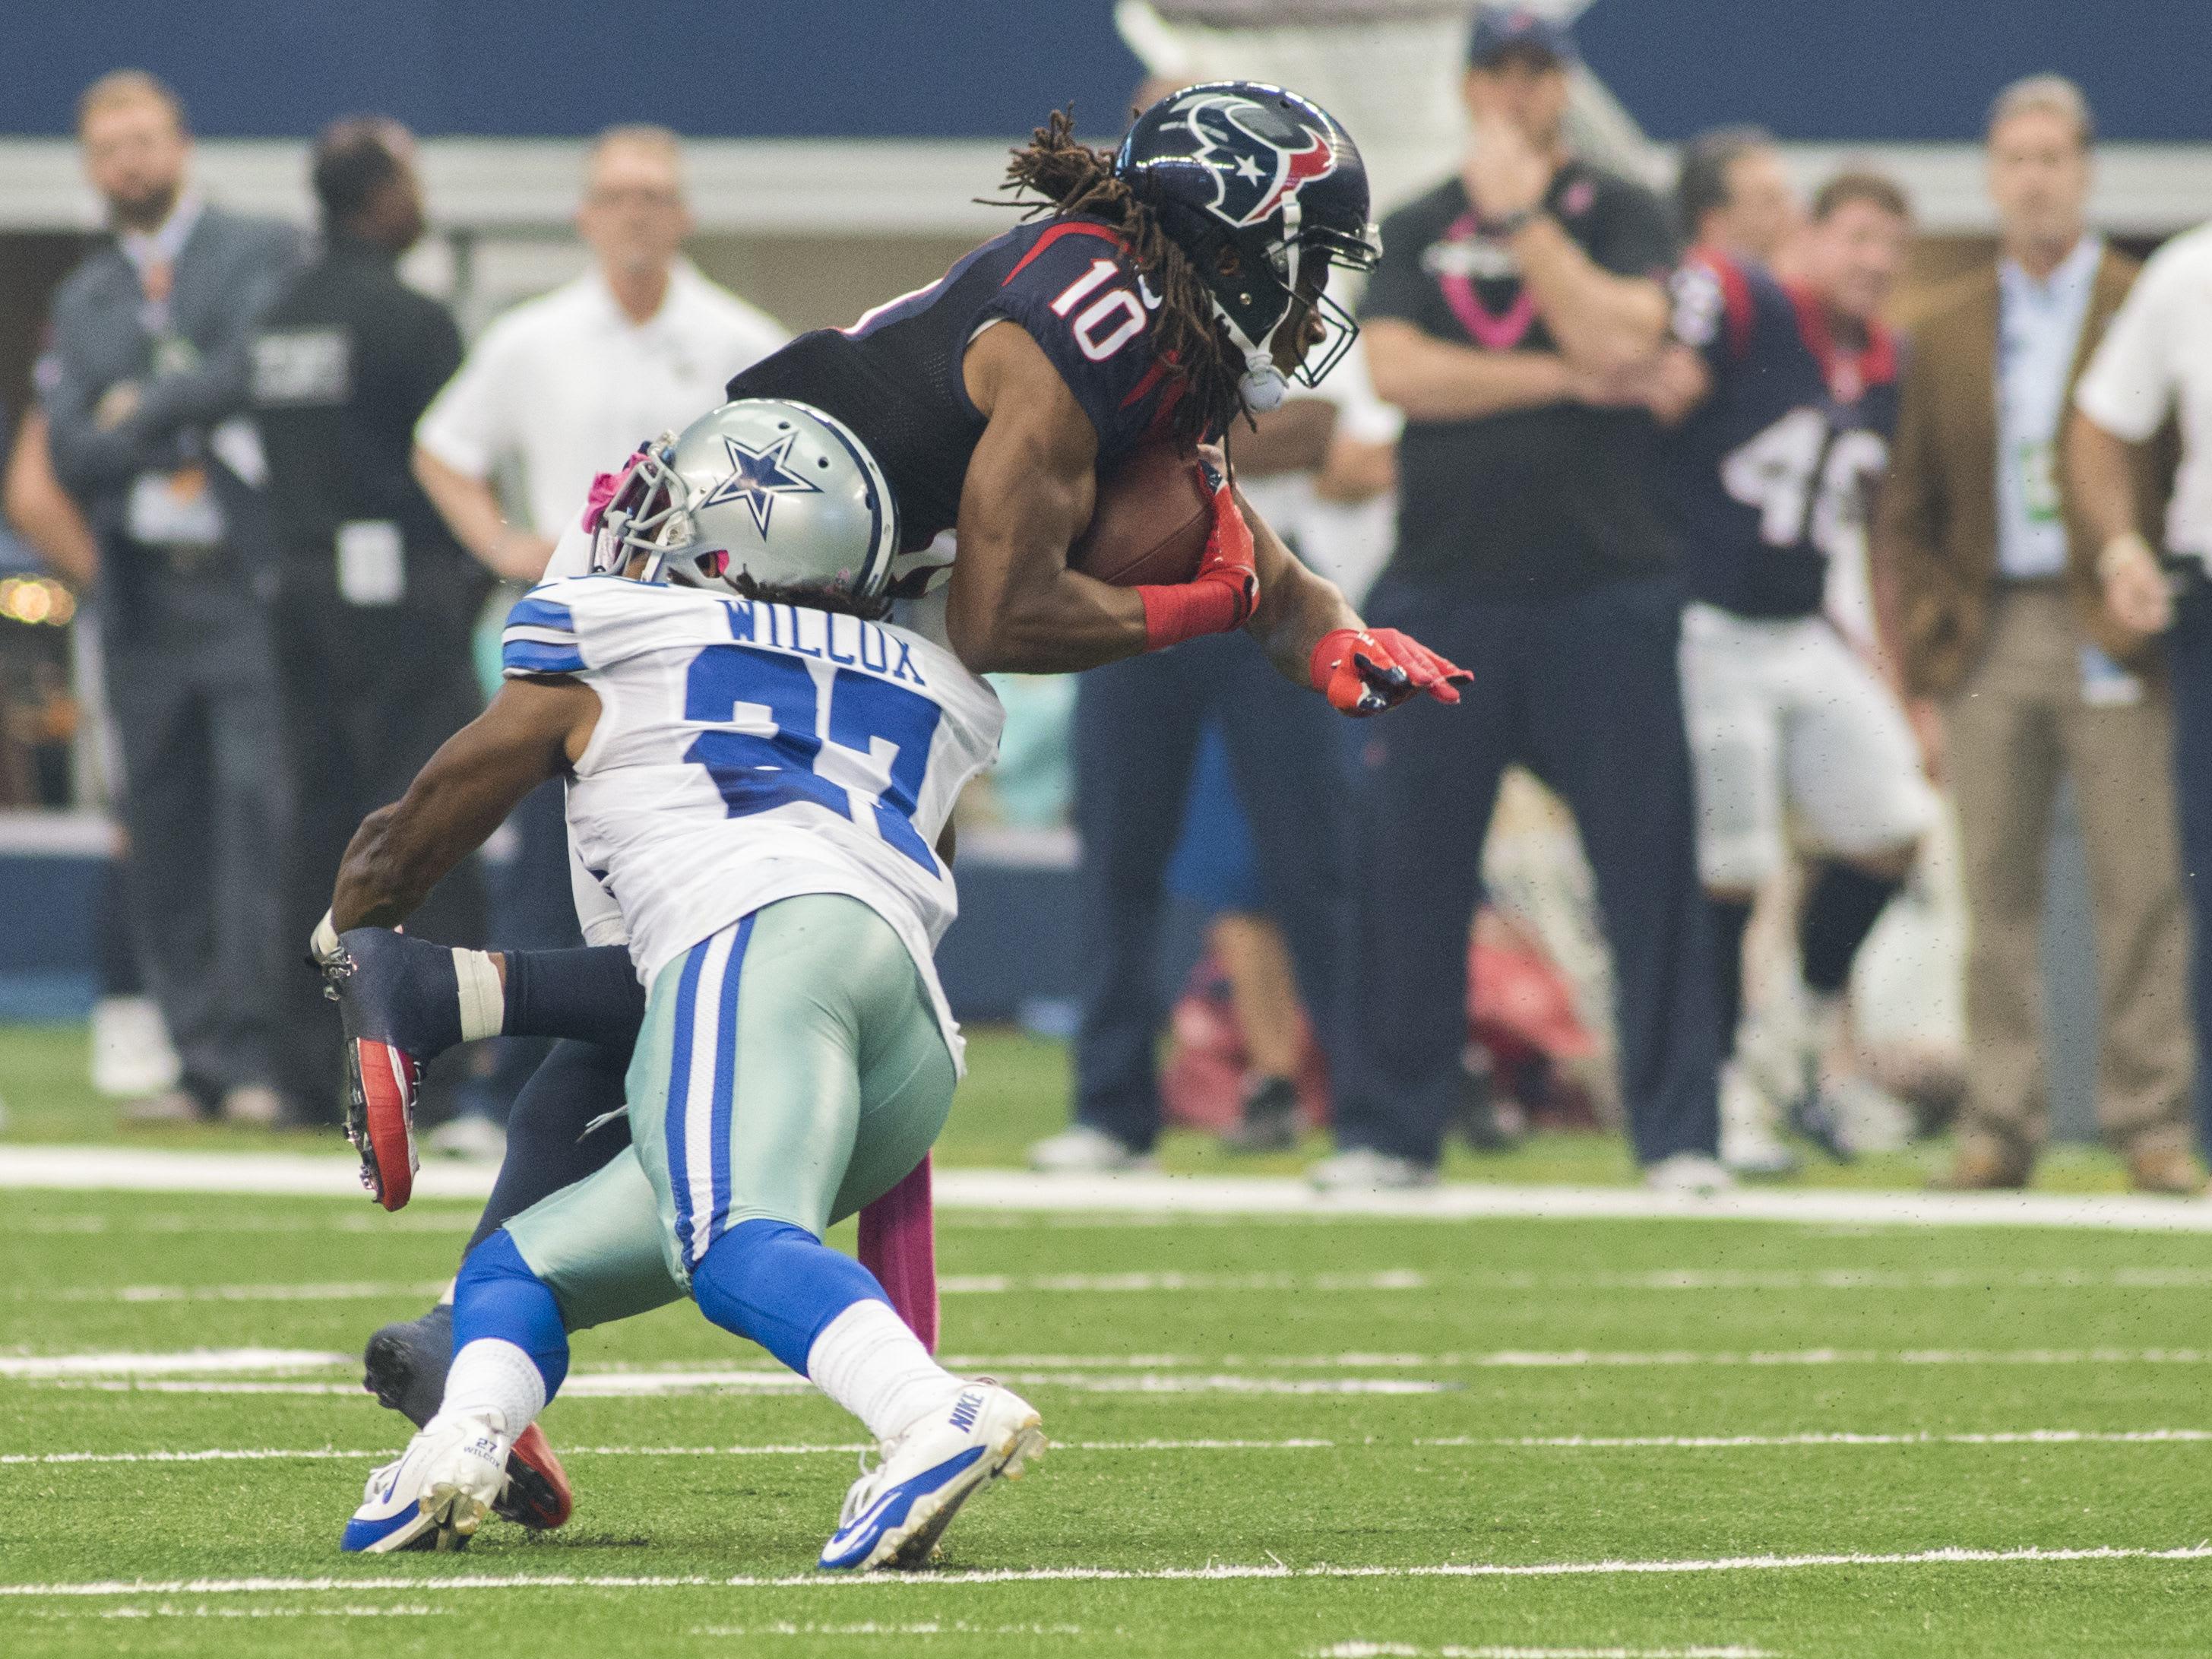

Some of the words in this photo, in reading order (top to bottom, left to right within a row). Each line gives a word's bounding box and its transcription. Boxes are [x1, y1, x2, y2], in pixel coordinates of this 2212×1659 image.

[1049, 259, 1147, 363] 10
[716, 599, 925, 685] WILCOX
[683, 645, 942, 880] 27
[949, 1392, 984, 1433] NIKE
[464, 1446, 501, 1469] WILCOX
[476, 1438, 498, 1453] 27
